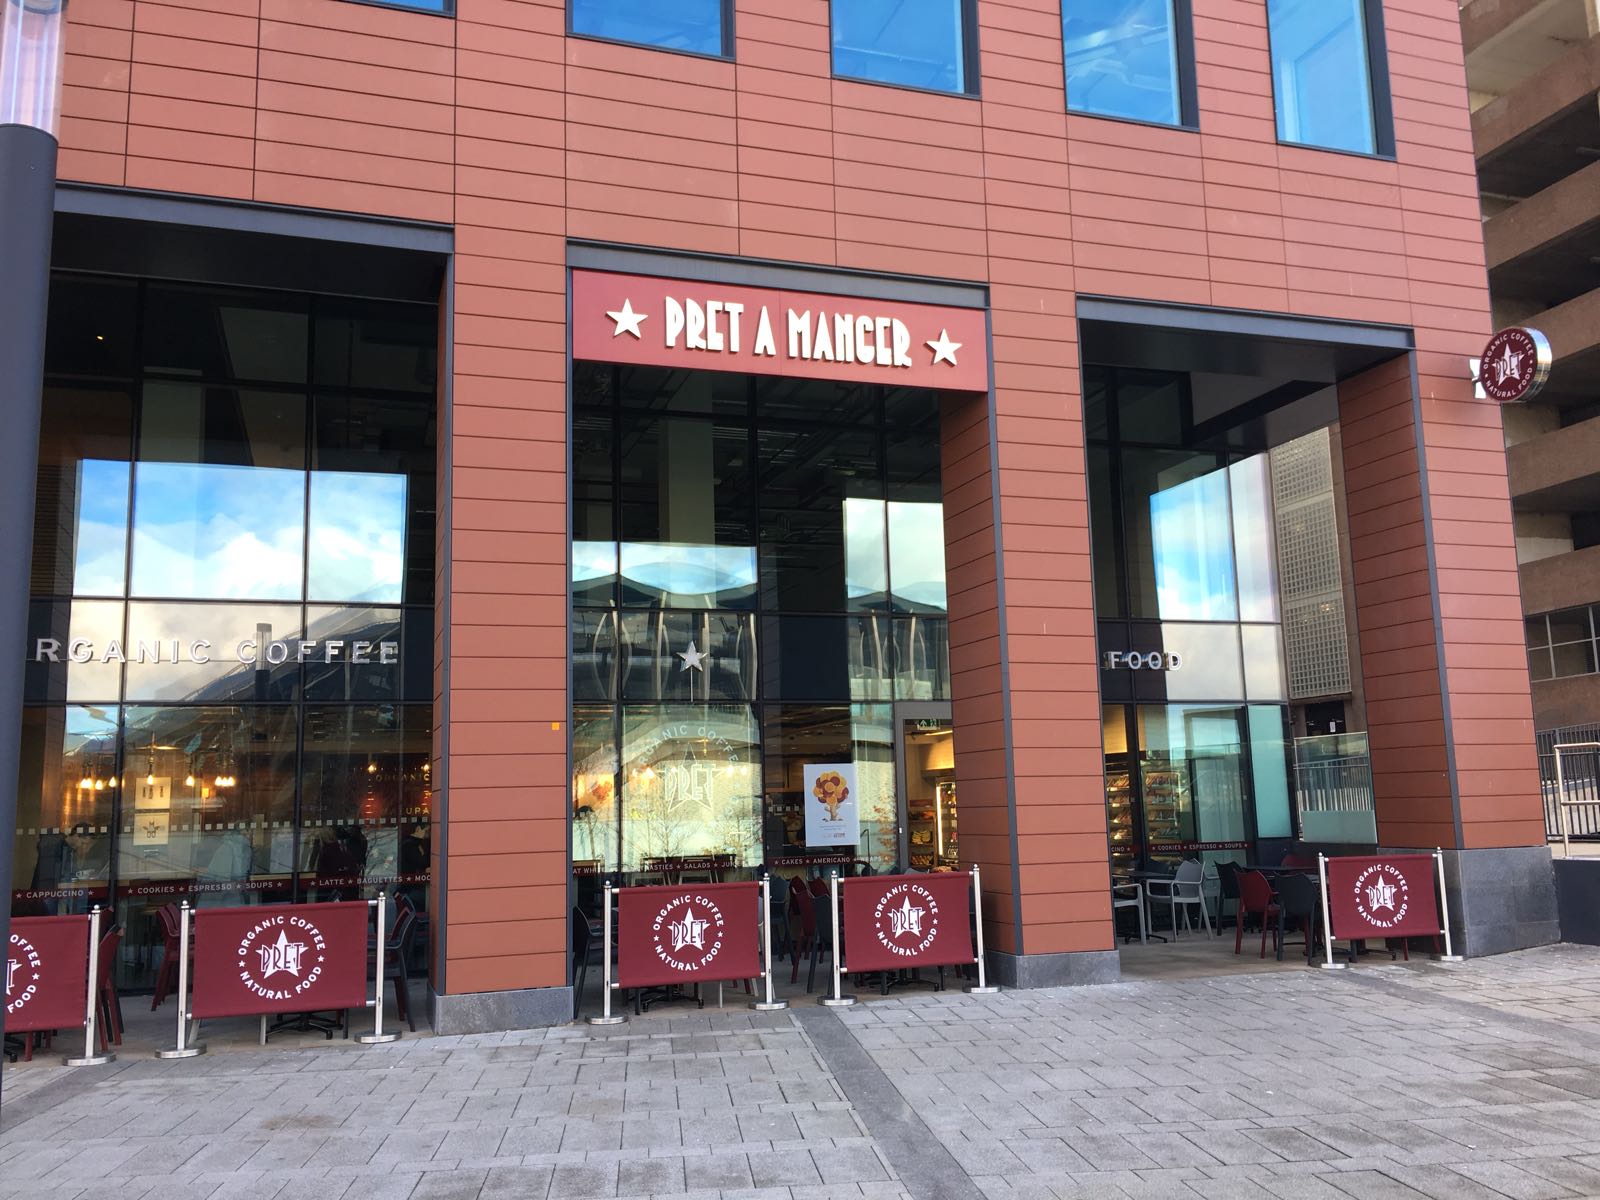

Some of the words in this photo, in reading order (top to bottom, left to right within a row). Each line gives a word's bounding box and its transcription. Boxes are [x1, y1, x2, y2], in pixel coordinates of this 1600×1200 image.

[664, 295, 744, 353] PRET
[754, 305, 777, 356] A
[787, 307, 913, 368] MANGER
[1483, 333, 1508, 370] ORGANIC
[1510, 332, 1534, 356] COFFEE
[1485, 381, 1517, 398] NATURAL
[1517, 367, 1533, 390] FOOD
[36, 639, 212, 663] RGANIC
[236, 638, 399, 664] COFFEE
[1109, 651, 1183, 671] FOOD
[664, 763, 716, 801] PRET
[813, 856, 851, 864] AMERICANO
[26, 889, 85, 899] CAPPUCCINO
[137, 886, 175, 895] COOKIES
[188, 883, 233, 892] ESPRESSO
[245, 881, 273, 889] SOUPS
[319, 878, 345, 886] LATTE
[356, 876, 403, 885] BAGUETTES
[1354, 864, 1382, 894] ORGANIC
[1384, 864, 1408, 892] COFFEE
[652, 895, 691, 931] ORGANIC
[695, 895, 724, 927] COFFEE
[874, 884, 908, 918] ORGANIC
[911, 884, 938, 915] COFFEE
[1357, 905, 1393, 928] NATURAL
[1393, 903, 1408, 924] FOOD
[671, 919, 707, 946] PRET
[891, 907, 922, 932] PRET
[9, 934, 41, 968] OFFEE
[238, 916, 284, 956] ORGANIC
[289, 916, 326, 951] COFFEE
[877, 931, 918, 956] NATURAL
[918, 928, 937, 952] FOOD
[260, 942, 304, 972] PRET
[655, 944, 699, 971] NATURAL
[700, 941, 722, 966] FOOD
[240, 971, 292, 1000] NATURAL
[295, 966, 321, 994] FOOD
[7, 984, 37, 1013] FOOD
